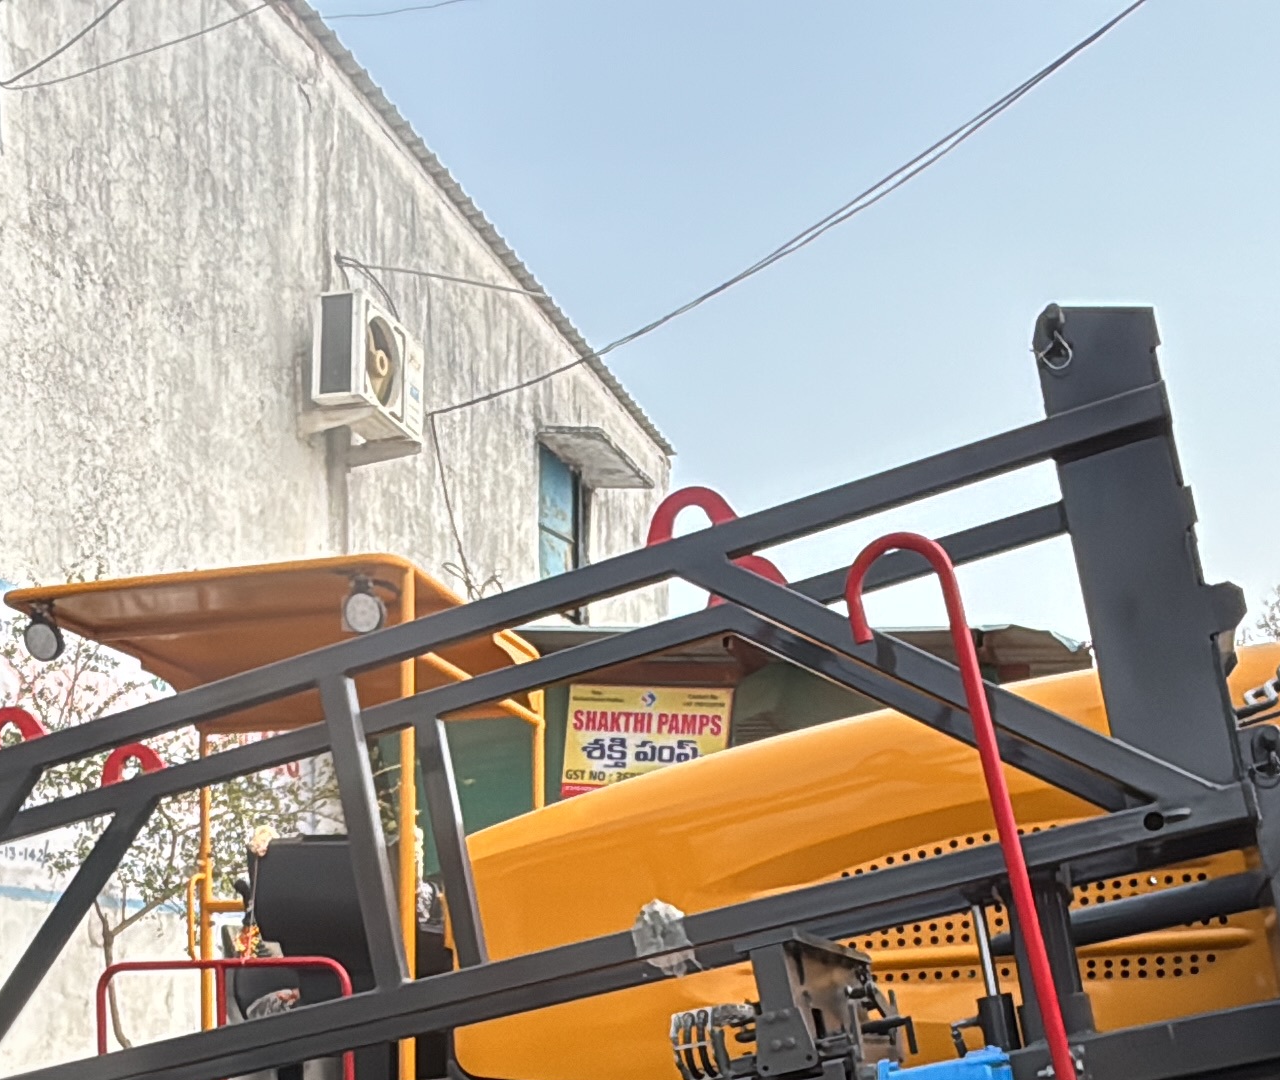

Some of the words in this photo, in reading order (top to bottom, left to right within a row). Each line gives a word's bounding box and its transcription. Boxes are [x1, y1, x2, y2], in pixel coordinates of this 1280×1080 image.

[572, 709, 652, 734] SHAKTHI
[656, 712, 722, 736] PAMPS
[565, 769, 585, 780] GST
[589, 770, 606, 781] NO
